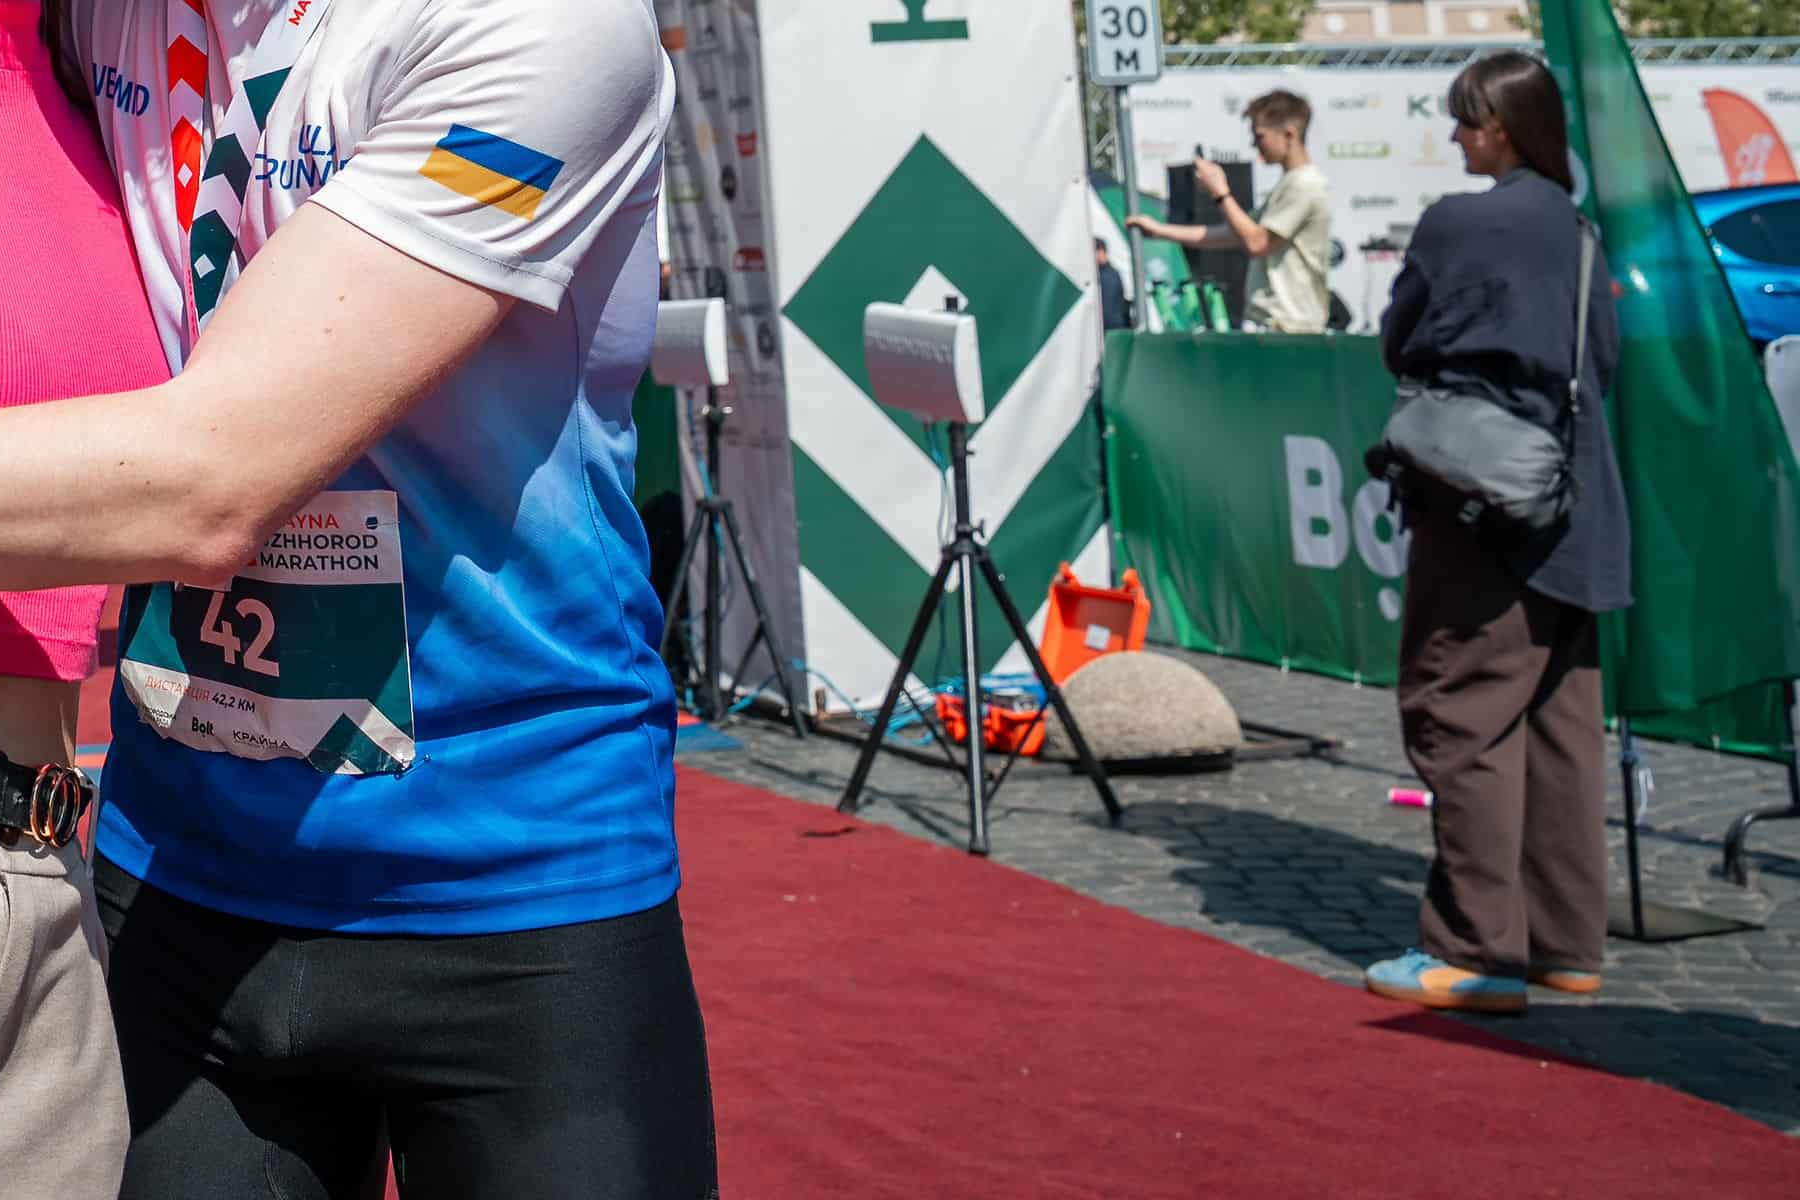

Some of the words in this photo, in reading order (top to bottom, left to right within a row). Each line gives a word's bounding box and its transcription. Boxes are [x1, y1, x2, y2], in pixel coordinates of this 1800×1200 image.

[1101, 6, 1147, 39] 30
[286, 513, 339, 529] AYNA
[1284, 434, 1413, 621] Bo
[264, 533, 378, 550] ZHHOROD
[260, 552, 379, 571] MARATHON
[200, 591, 280, 678] 42
[144, 676, 210, 701] ДИСТАНЦІЯ
[212, 691, 236, 709] 42,2
[237, 699, 256, 713] КМ
[191, 716, 215, 738] Bolt
